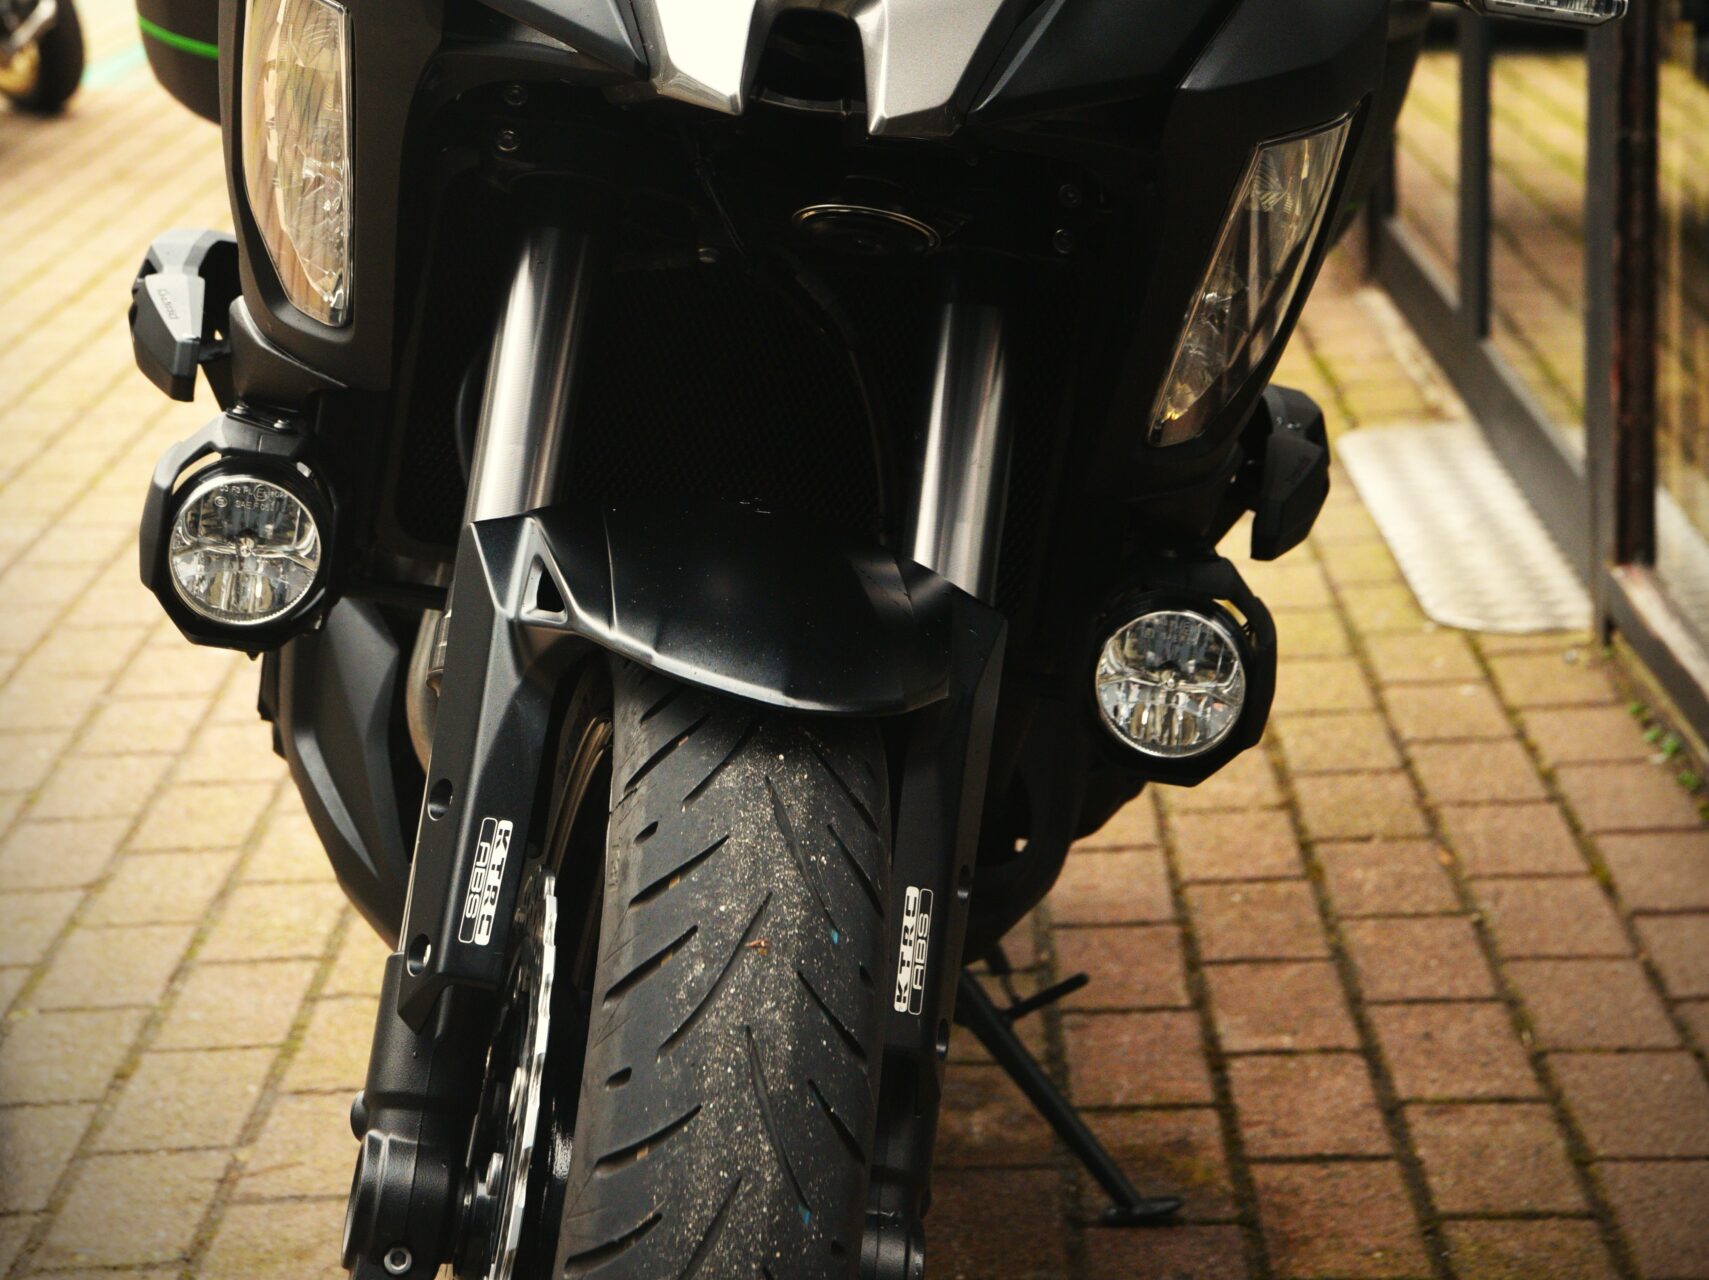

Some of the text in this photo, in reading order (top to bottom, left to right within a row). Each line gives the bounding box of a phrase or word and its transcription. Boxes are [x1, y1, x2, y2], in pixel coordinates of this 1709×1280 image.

[465, 841, 491, 919] ABS
[477, 827, 512, 937] KTRC
[896, 894, 917, 1004] KTRC
[912, 912, 930, 990] ABS
